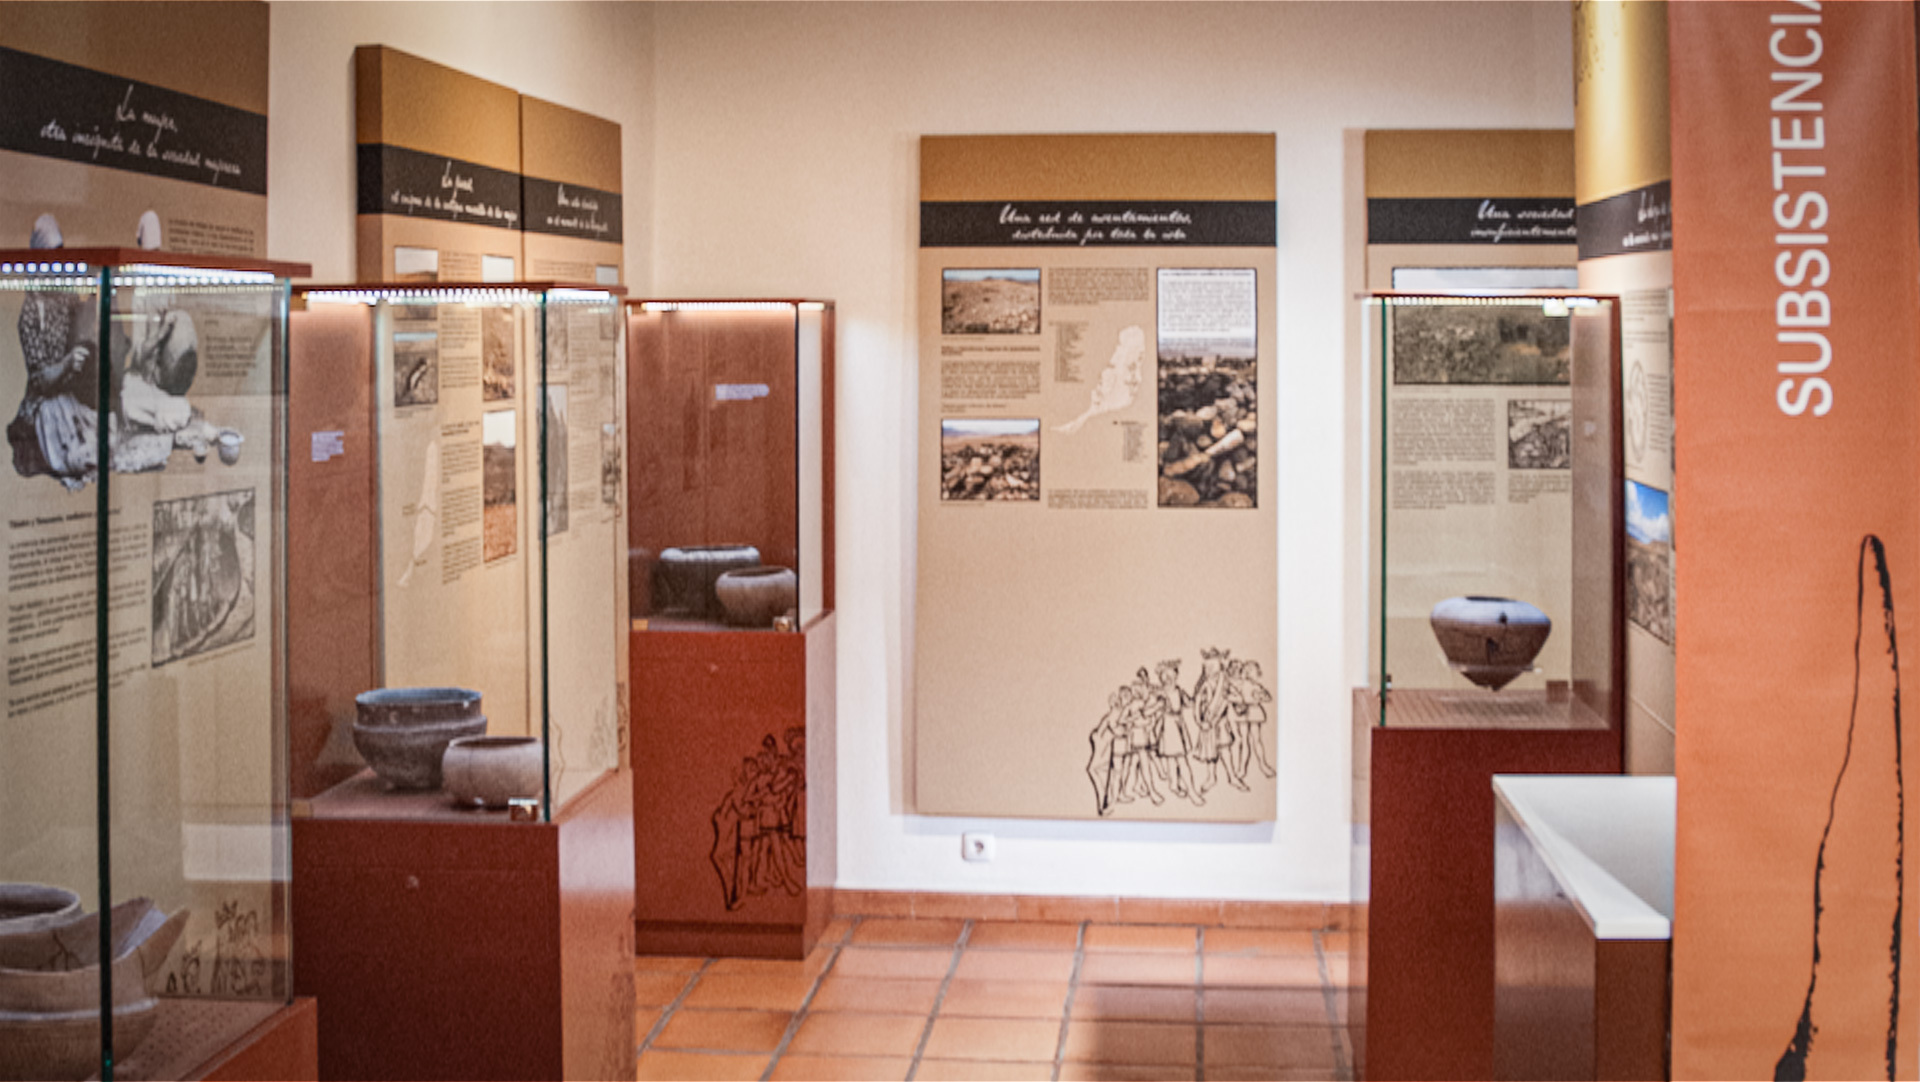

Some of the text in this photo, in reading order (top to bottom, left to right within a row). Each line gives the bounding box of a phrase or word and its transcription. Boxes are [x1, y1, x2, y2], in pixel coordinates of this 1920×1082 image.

[1000, 203, 1031, 224] Una
[1039, 210, 1061, 224] red
[1067, 210, 1083, 223] de
[1478, 199, 1511, 220] Una
[1769, 0, 1833, 417] SUBSISTENCI
[1080, 227, 1104, 246] por
[1143, 227, 1156, 240] la
